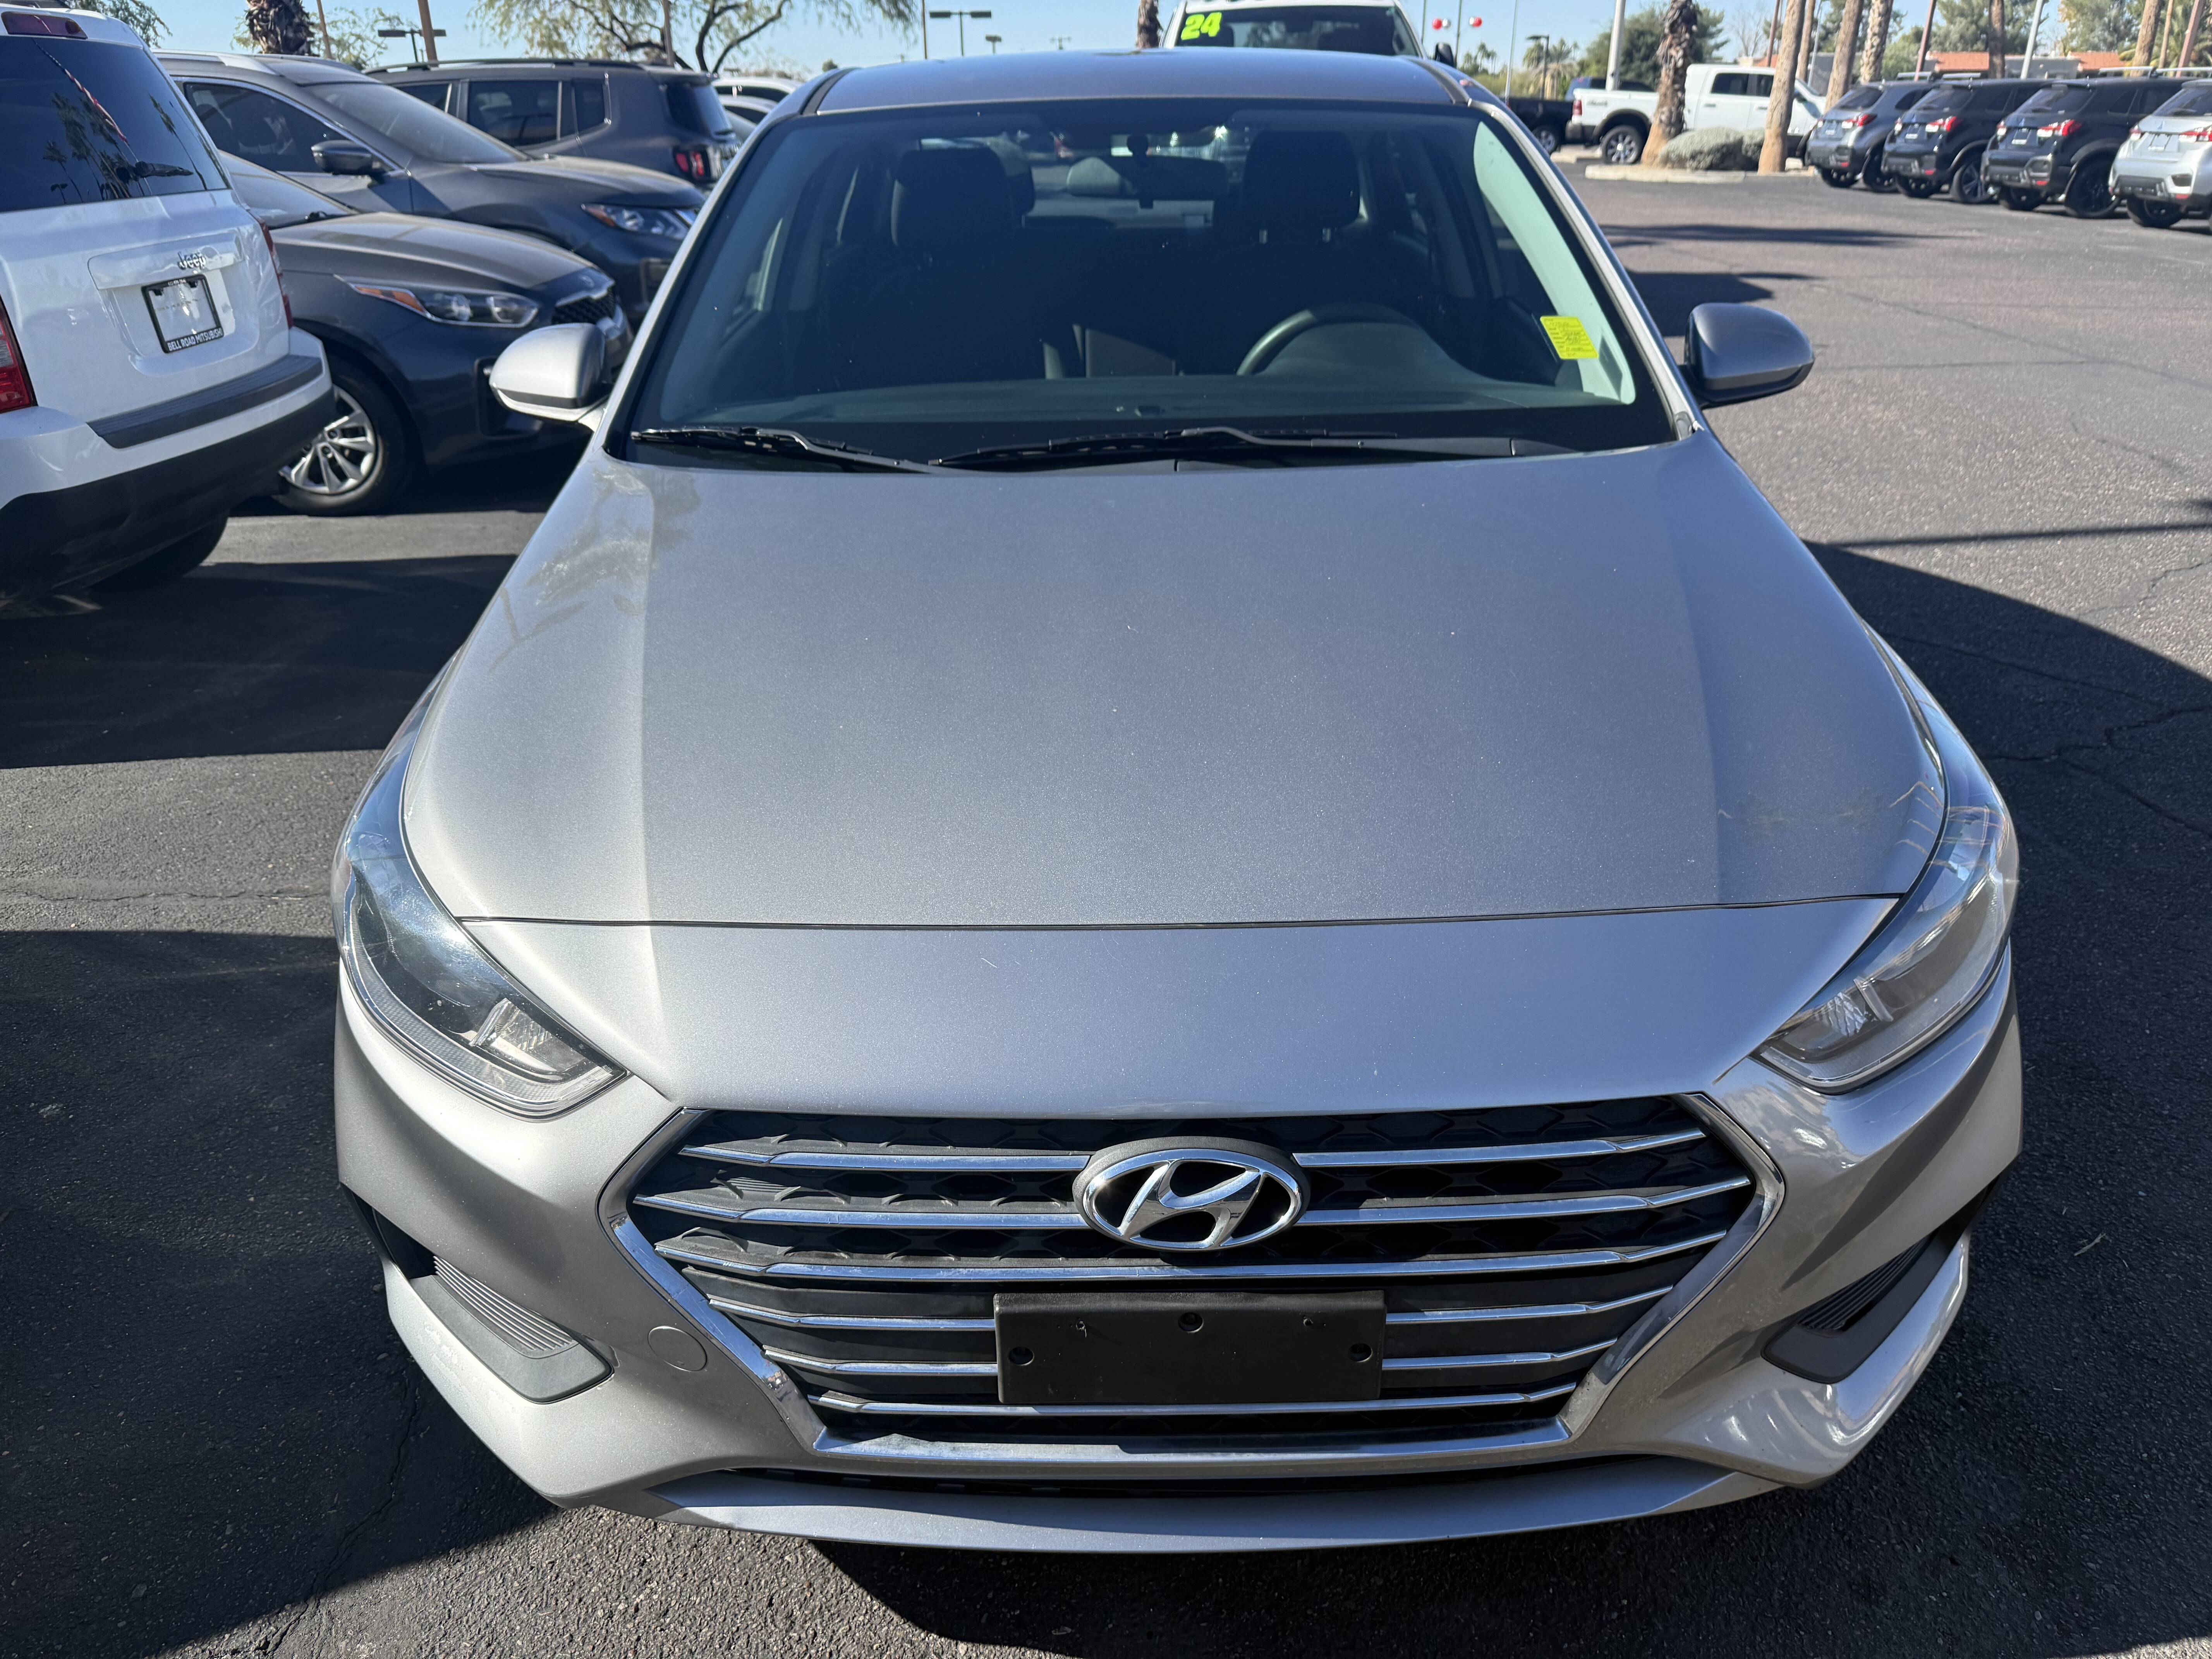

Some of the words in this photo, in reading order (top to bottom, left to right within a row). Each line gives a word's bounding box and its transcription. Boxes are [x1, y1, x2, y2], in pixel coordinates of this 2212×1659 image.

[1181, 12, 1222, 40] 24
[177, 251, 206, 270] Jeep
[167, 340, 182, 351] BELL
[180, 336, 196, 347] ROAD
[195, 328, 223, 343] MITSUBISHI
